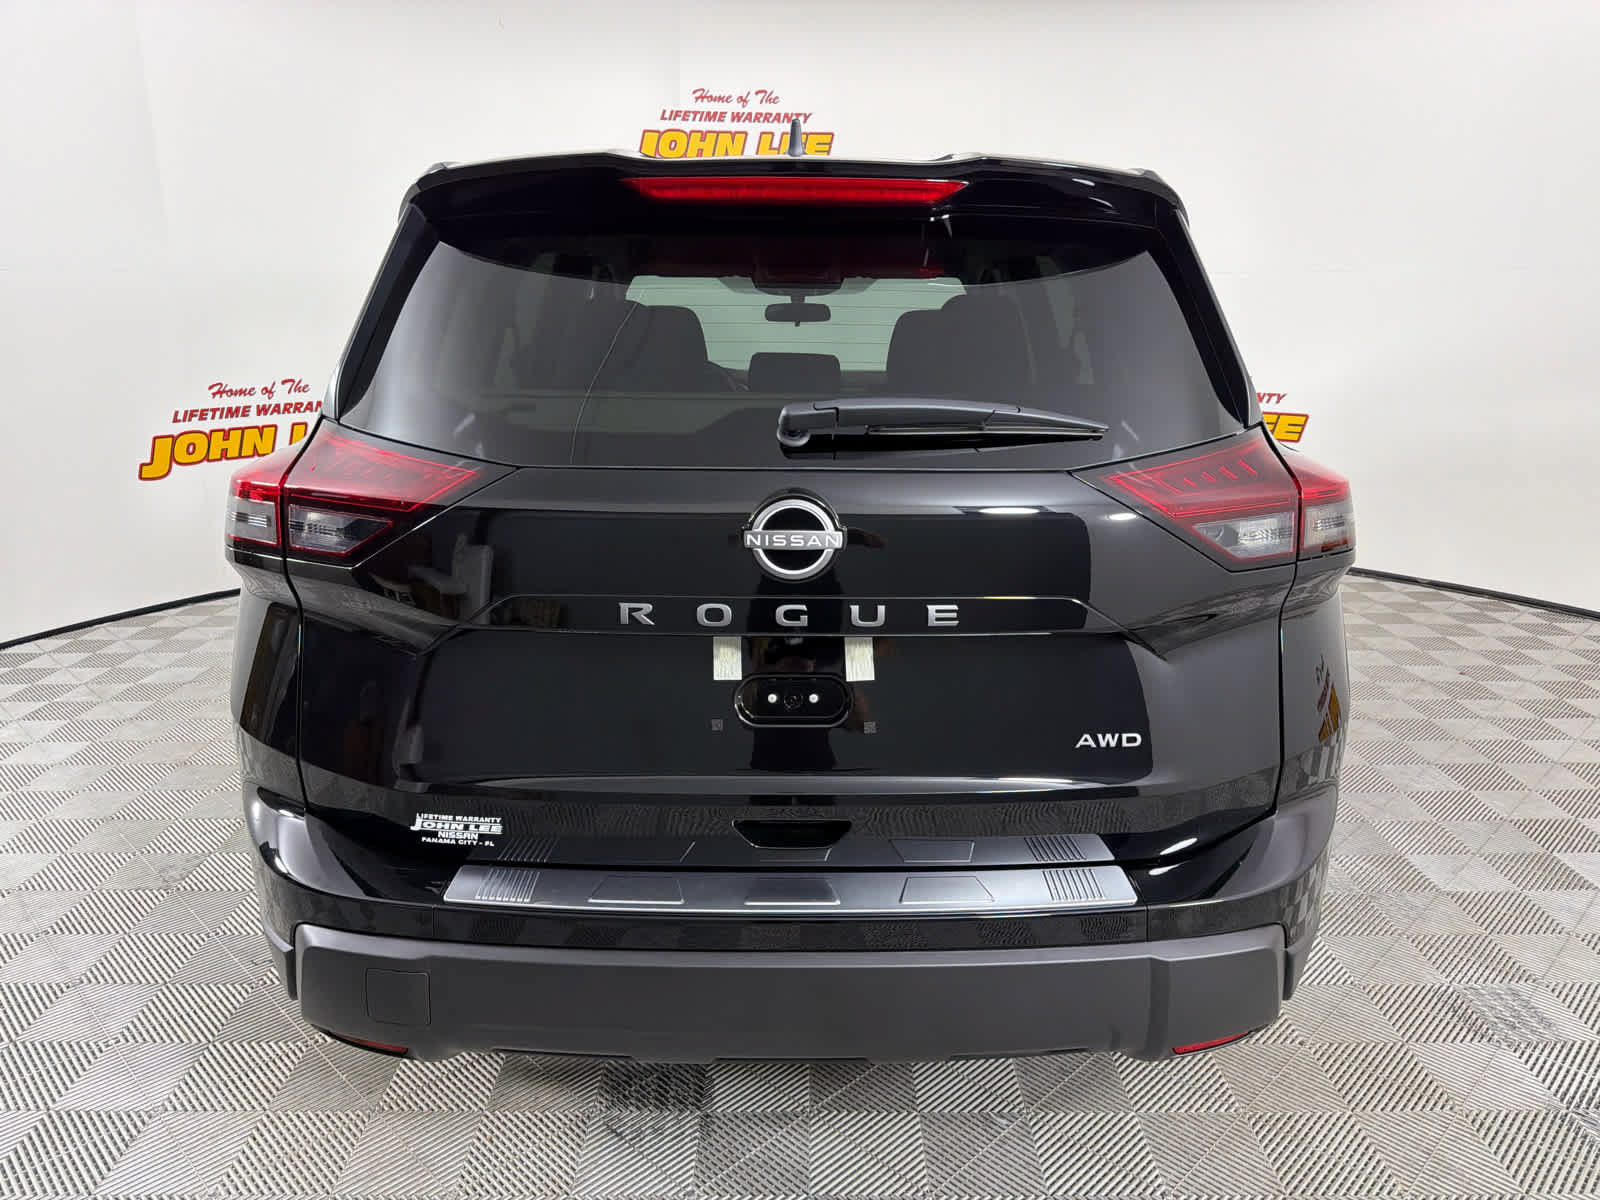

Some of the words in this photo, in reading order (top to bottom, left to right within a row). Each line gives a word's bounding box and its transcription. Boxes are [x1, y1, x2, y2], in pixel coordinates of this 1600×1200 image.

[692, 88, 733, 105] Home
[736, 91, 751, 108] of
[755, 89, 781, 105] The
[660, 109, 728, 123] LIFETIME
[730, 111, 813, 124] WARRANTY
[208, 382, 256, 399] Home
[261, 381, 277, 400] of
[281, 378, 311, 395] The
[172, 404, 251, 423] LIFETIME
[138, 424, 278, 481] JOHN
[746, 533, 839, 547] NISSAN
[618, 602, 960, 627] ROGUE
[1074, 732, 1142, 748] AWD
[410, 818, 465, 831] JOHN
[468, 823, 503, 832] LEE
[416, 813, 454, 821] LIFETIME
[455, 815, 502, 823] WARRANTY
[421, 836, 456, 845] PANAMA
[437, 831, 479, 840] NISSAN
